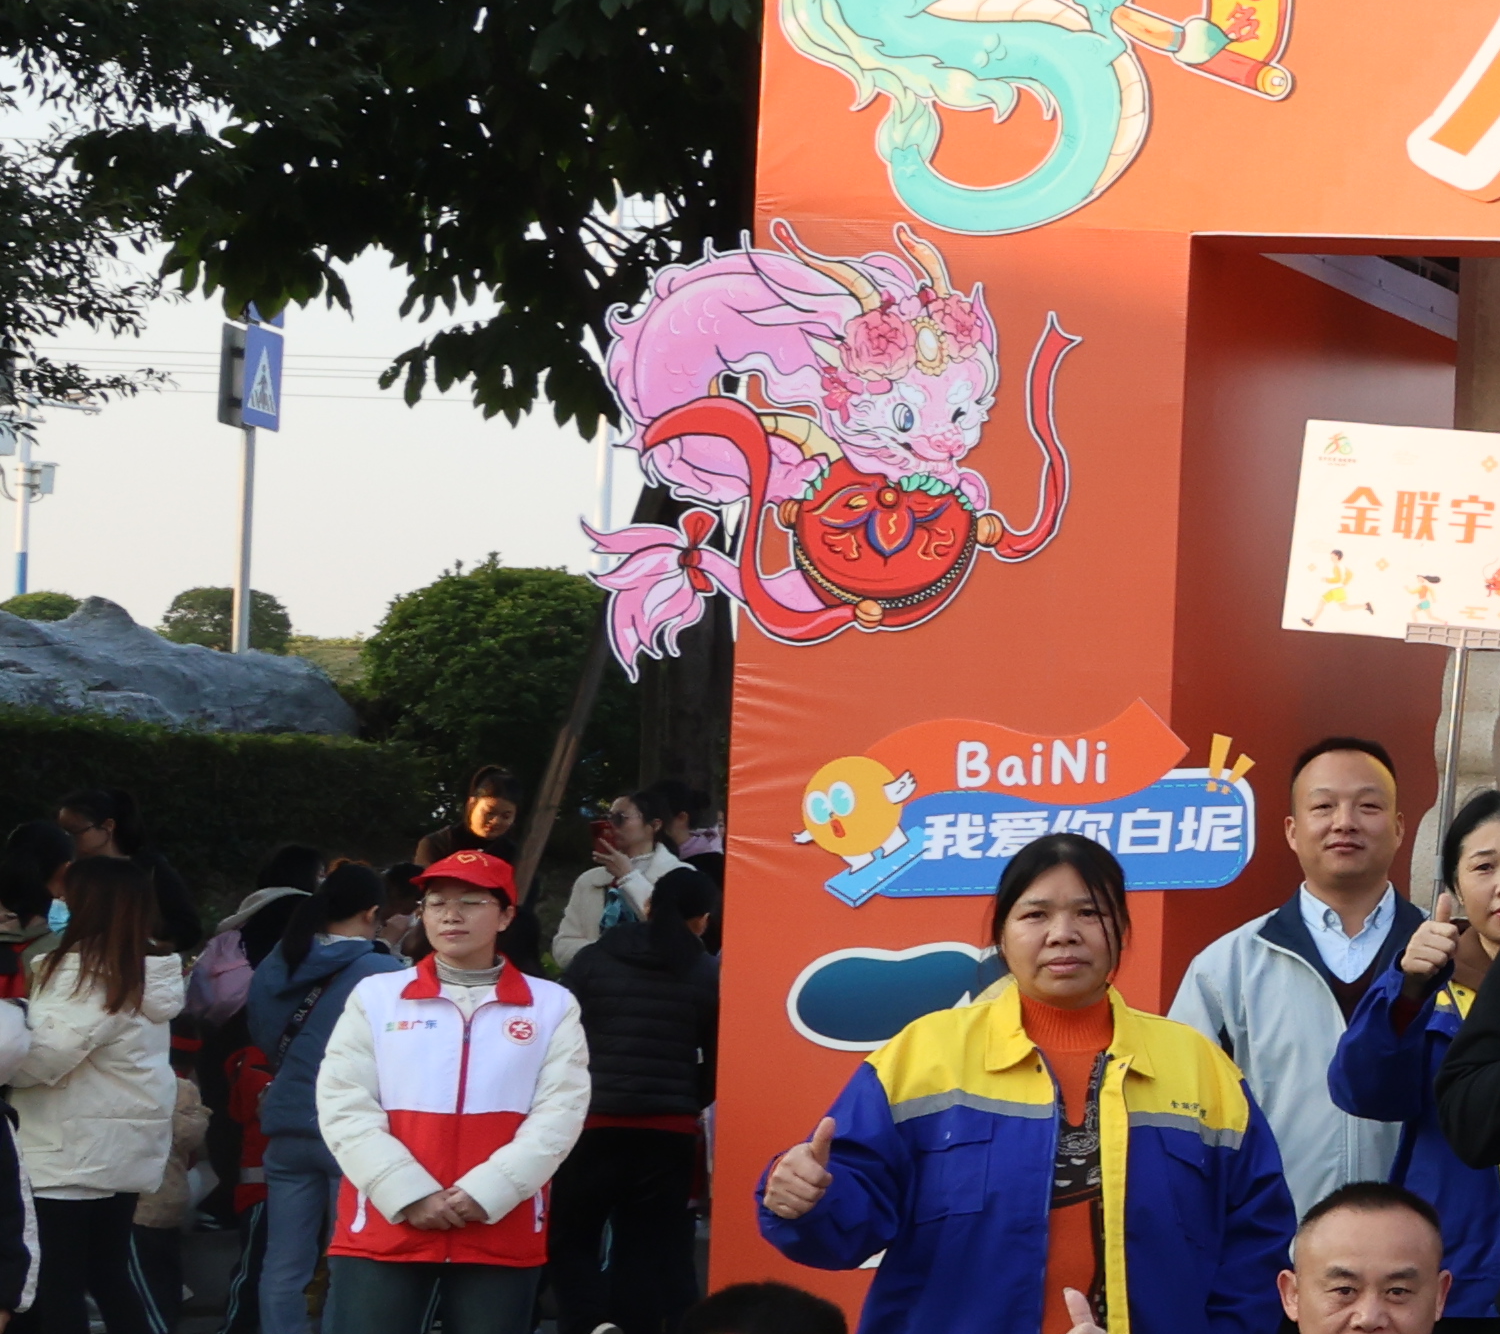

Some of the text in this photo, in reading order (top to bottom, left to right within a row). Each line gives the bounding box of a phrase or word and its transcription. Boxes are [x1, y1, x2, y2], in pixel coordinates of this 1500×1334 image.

[956, 738, 1108, 788] BaiNi
[922, 805, 1243, 860] 我爱你白坭
